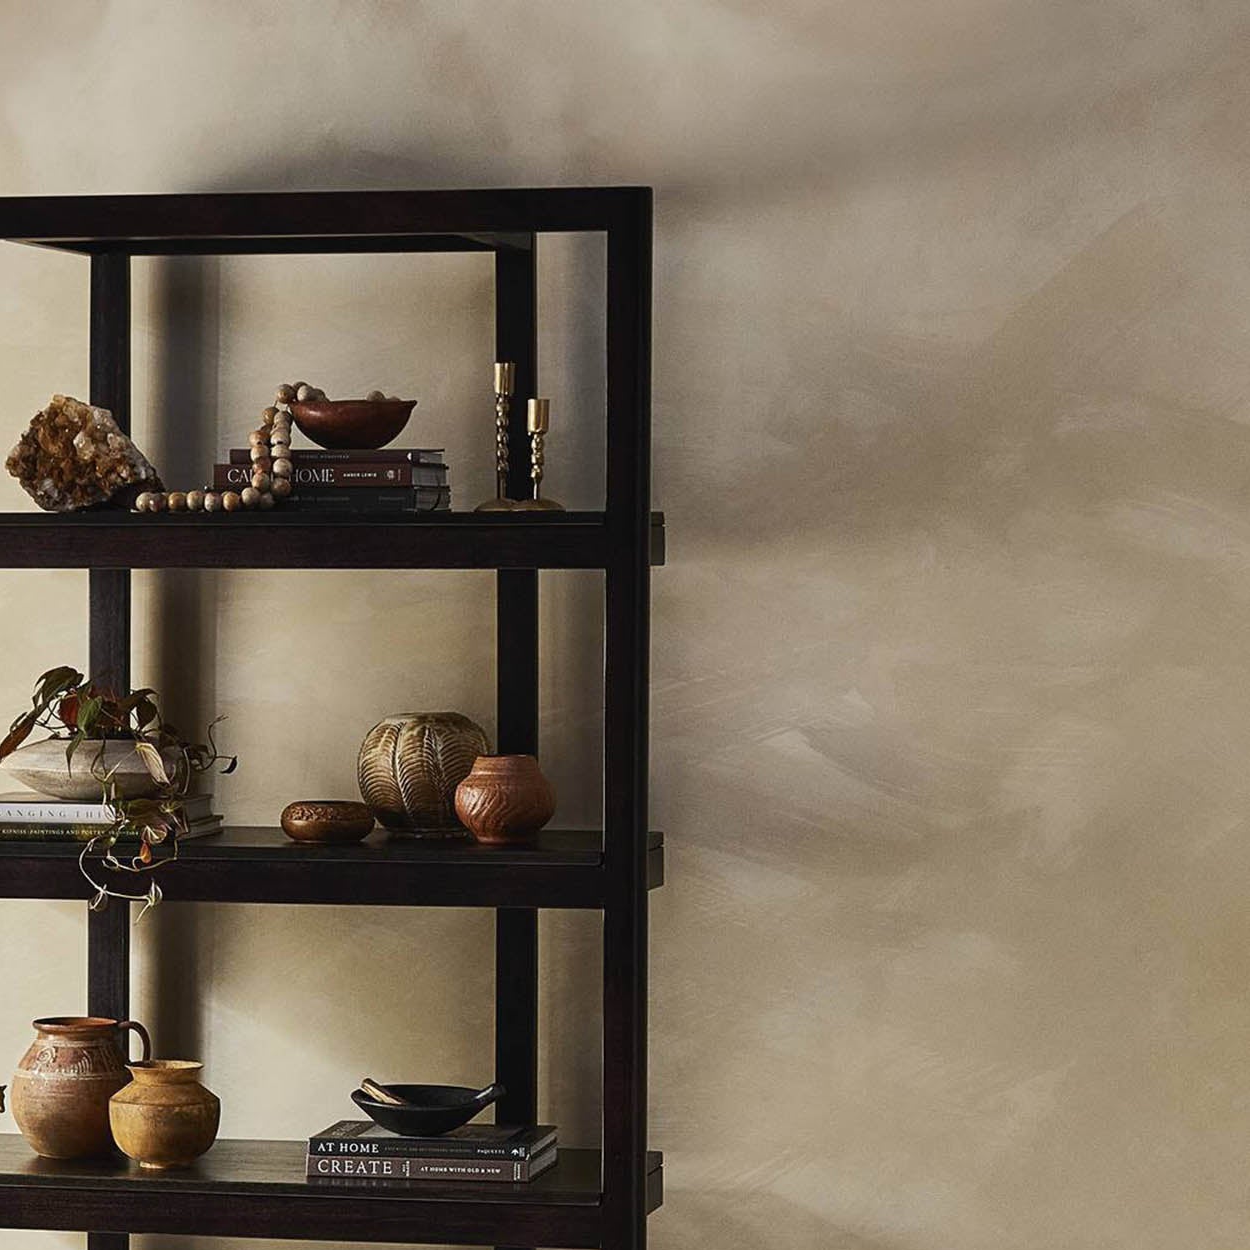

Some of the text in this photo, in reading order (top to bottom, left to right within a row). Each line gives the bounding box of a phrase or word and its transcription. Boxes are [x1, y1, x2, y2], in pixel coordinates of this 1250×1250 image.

[227, 468, 254, 483] CA
[317, 1142, 335, 1153] AT
[340, 1142, 380, 1154] HOME
[317, 1158, 393, 1175] CREATE
[448, 1166, 466, 1174] WITH
